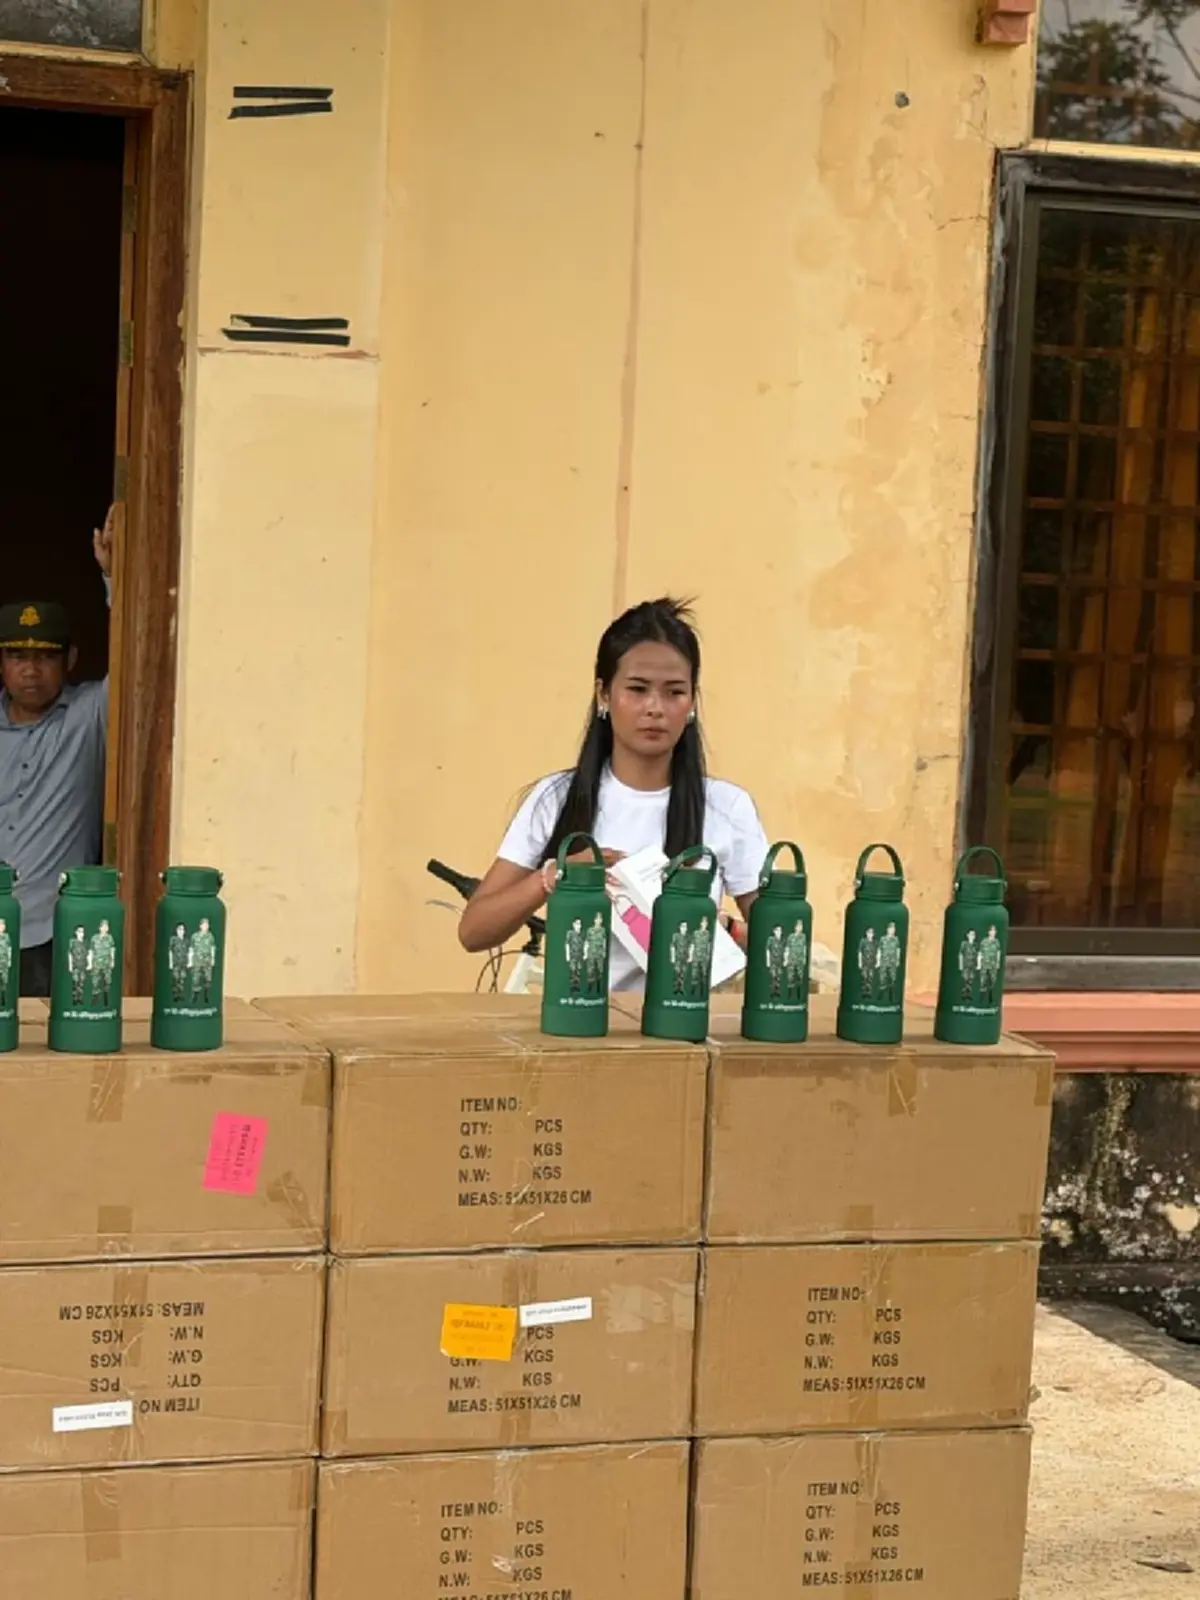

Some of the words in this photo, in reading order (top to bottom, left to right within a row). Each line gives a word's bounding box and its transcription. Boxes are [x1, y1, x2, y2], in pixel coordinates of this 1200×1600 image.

[460, 1098, 495, 1112] ITEM
[497, 1097, 522, 1111] NO:
[460, 1121, 492, 1136] QTY:
[534, 1119, 563, 1133] PCS
[459, 1144, 492, 1159] G.W:
[533, 1142, 563, 1156] KGS
[458, 1168, 490, 1183] N.W:
[532, 1165, 562, 1180] KGS
[458, 1192, 503, 1206] MEAS:
[570, 1189, 592, 1203] CM
[808, 1287, 838, 1302] ITEM
[841, 1286, 865, 1301] NO:
[59, 1305, 82, 1320] CM
[86, 1303, 153, 1320] 51X51X26
[158, 1302, 204, 1317] MEAS:
[806, 1310, 836, 1324] QTY:
[875, 1308, 902, 1322] PCS
[92, 1329, 124, 1344] KGS
[170, 1326, 203, 1340] N.W:
[526, 1327, 554, 1341] PCS
[805, 1333, 835, 1346] G.W:
[873, 1330, 901, 1344] KGS
[90, 1353, 122, 1368] KGS
[168, 1349, 203, 1364] G.W:
[524, 1349, 554, 1363] KGS
[804, 1355, 833, 1369] N.W:
[871, 1353, 899, 1367] KGS
[90, 1377, 120, 1392] PCS
[168, 1373, 201, 1388] QTY:
[449, 1376, 480, 1391] N.W:
[522, 1372, 552, 1386] KGS
[803, 1377, 844, 1392] MEAS:
[845, 1377, 904, 1391] 51X51X26
[906, 1376, 926, 1389] CM
[164, 1397, 200, 1412] ITEM
[448, 1399, 492, 1413] MEAS:
[495, 1396, 557, 1412] 51X51X26
[559, 1394, 581, 1408] CM
[807, 1482, 837, 1496] ITEM
[441, 1503, 474, 1518] ITEM
[478, 1501, 503, 1516] NO:
[805, 1505, 835, 1519] QTY:
[874, 1502, 901, 1517] PCS
[440, 1526, 472, 1541] QTY:
[516, 1520, 544, 1535] PCS
[804, 1527, 834, 1542] G.W:
[872, 1524, 900, 1538] KGS
[439, 1550, 472, 1565] G.W:
[514, 1544, 544, 1558] KGS
[803, 1550, 832, 1564] N.W:
[870, 1547, 898, 1560] KGS
[438, 1572, 470, 1588] N.W:
[512, 1567, 542, 1582] KGS
[802, 1571, 843, 1586] MEAS:
[844, 1568, 903, 1584] 51X51X26
[905, 1567, 924, 1581] CM
